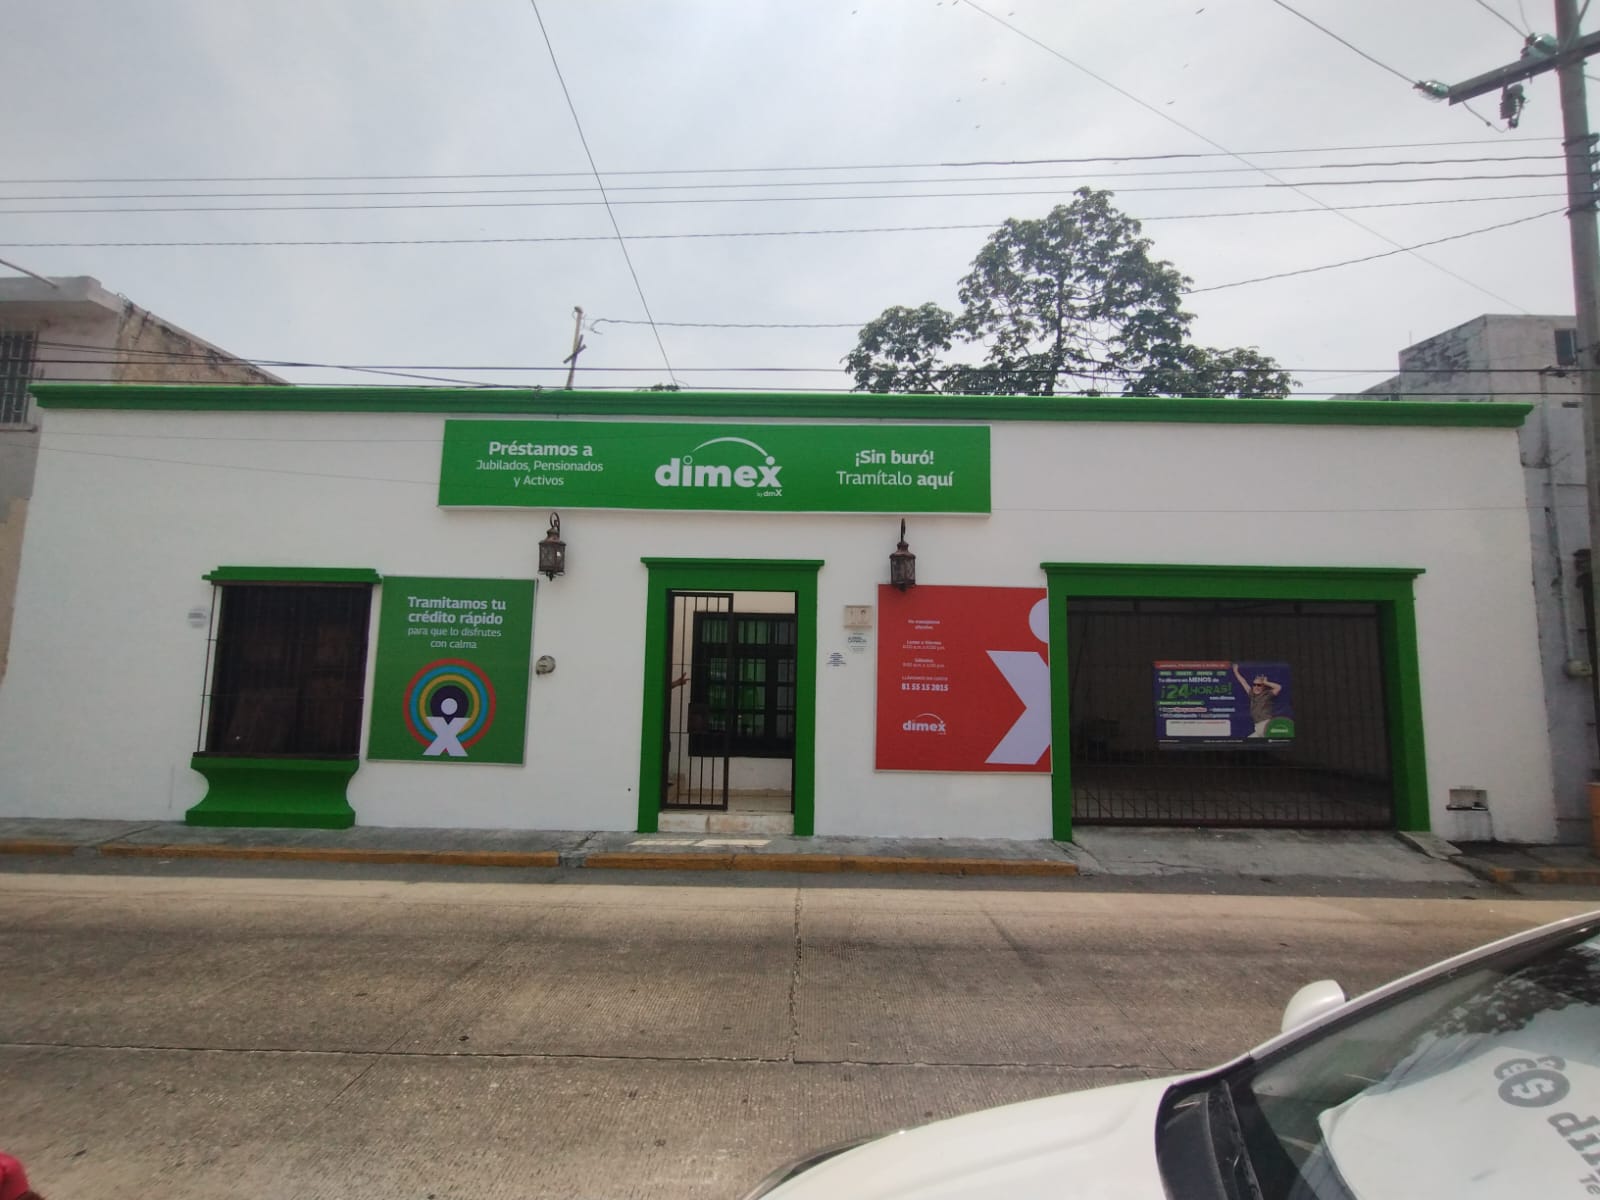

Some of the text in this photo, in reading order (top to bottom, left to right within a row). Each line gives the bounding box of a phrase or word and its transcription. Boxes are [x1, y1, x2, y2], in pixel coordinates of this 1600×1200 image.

[488, 440, 593, 456] Préstamos a
[855, 449, 934, 467] ¡Sin buró!
[476, 459, 604, 473] Jubilados, Pensionados
[654, 455, 783, 488] dimex
[513, 474, 565, 488] y Activos
[836, 469, 954, 490] Tramítalo aquí
[407, 596, 507, 610] Tramitamos tu
[408, 610, 503, 627] crédito rápido
[407, 626, 502, 637] para que lo disfrutes
[430, 639, 477, 649] con calma
[902, 719, 946, 732] dimex
